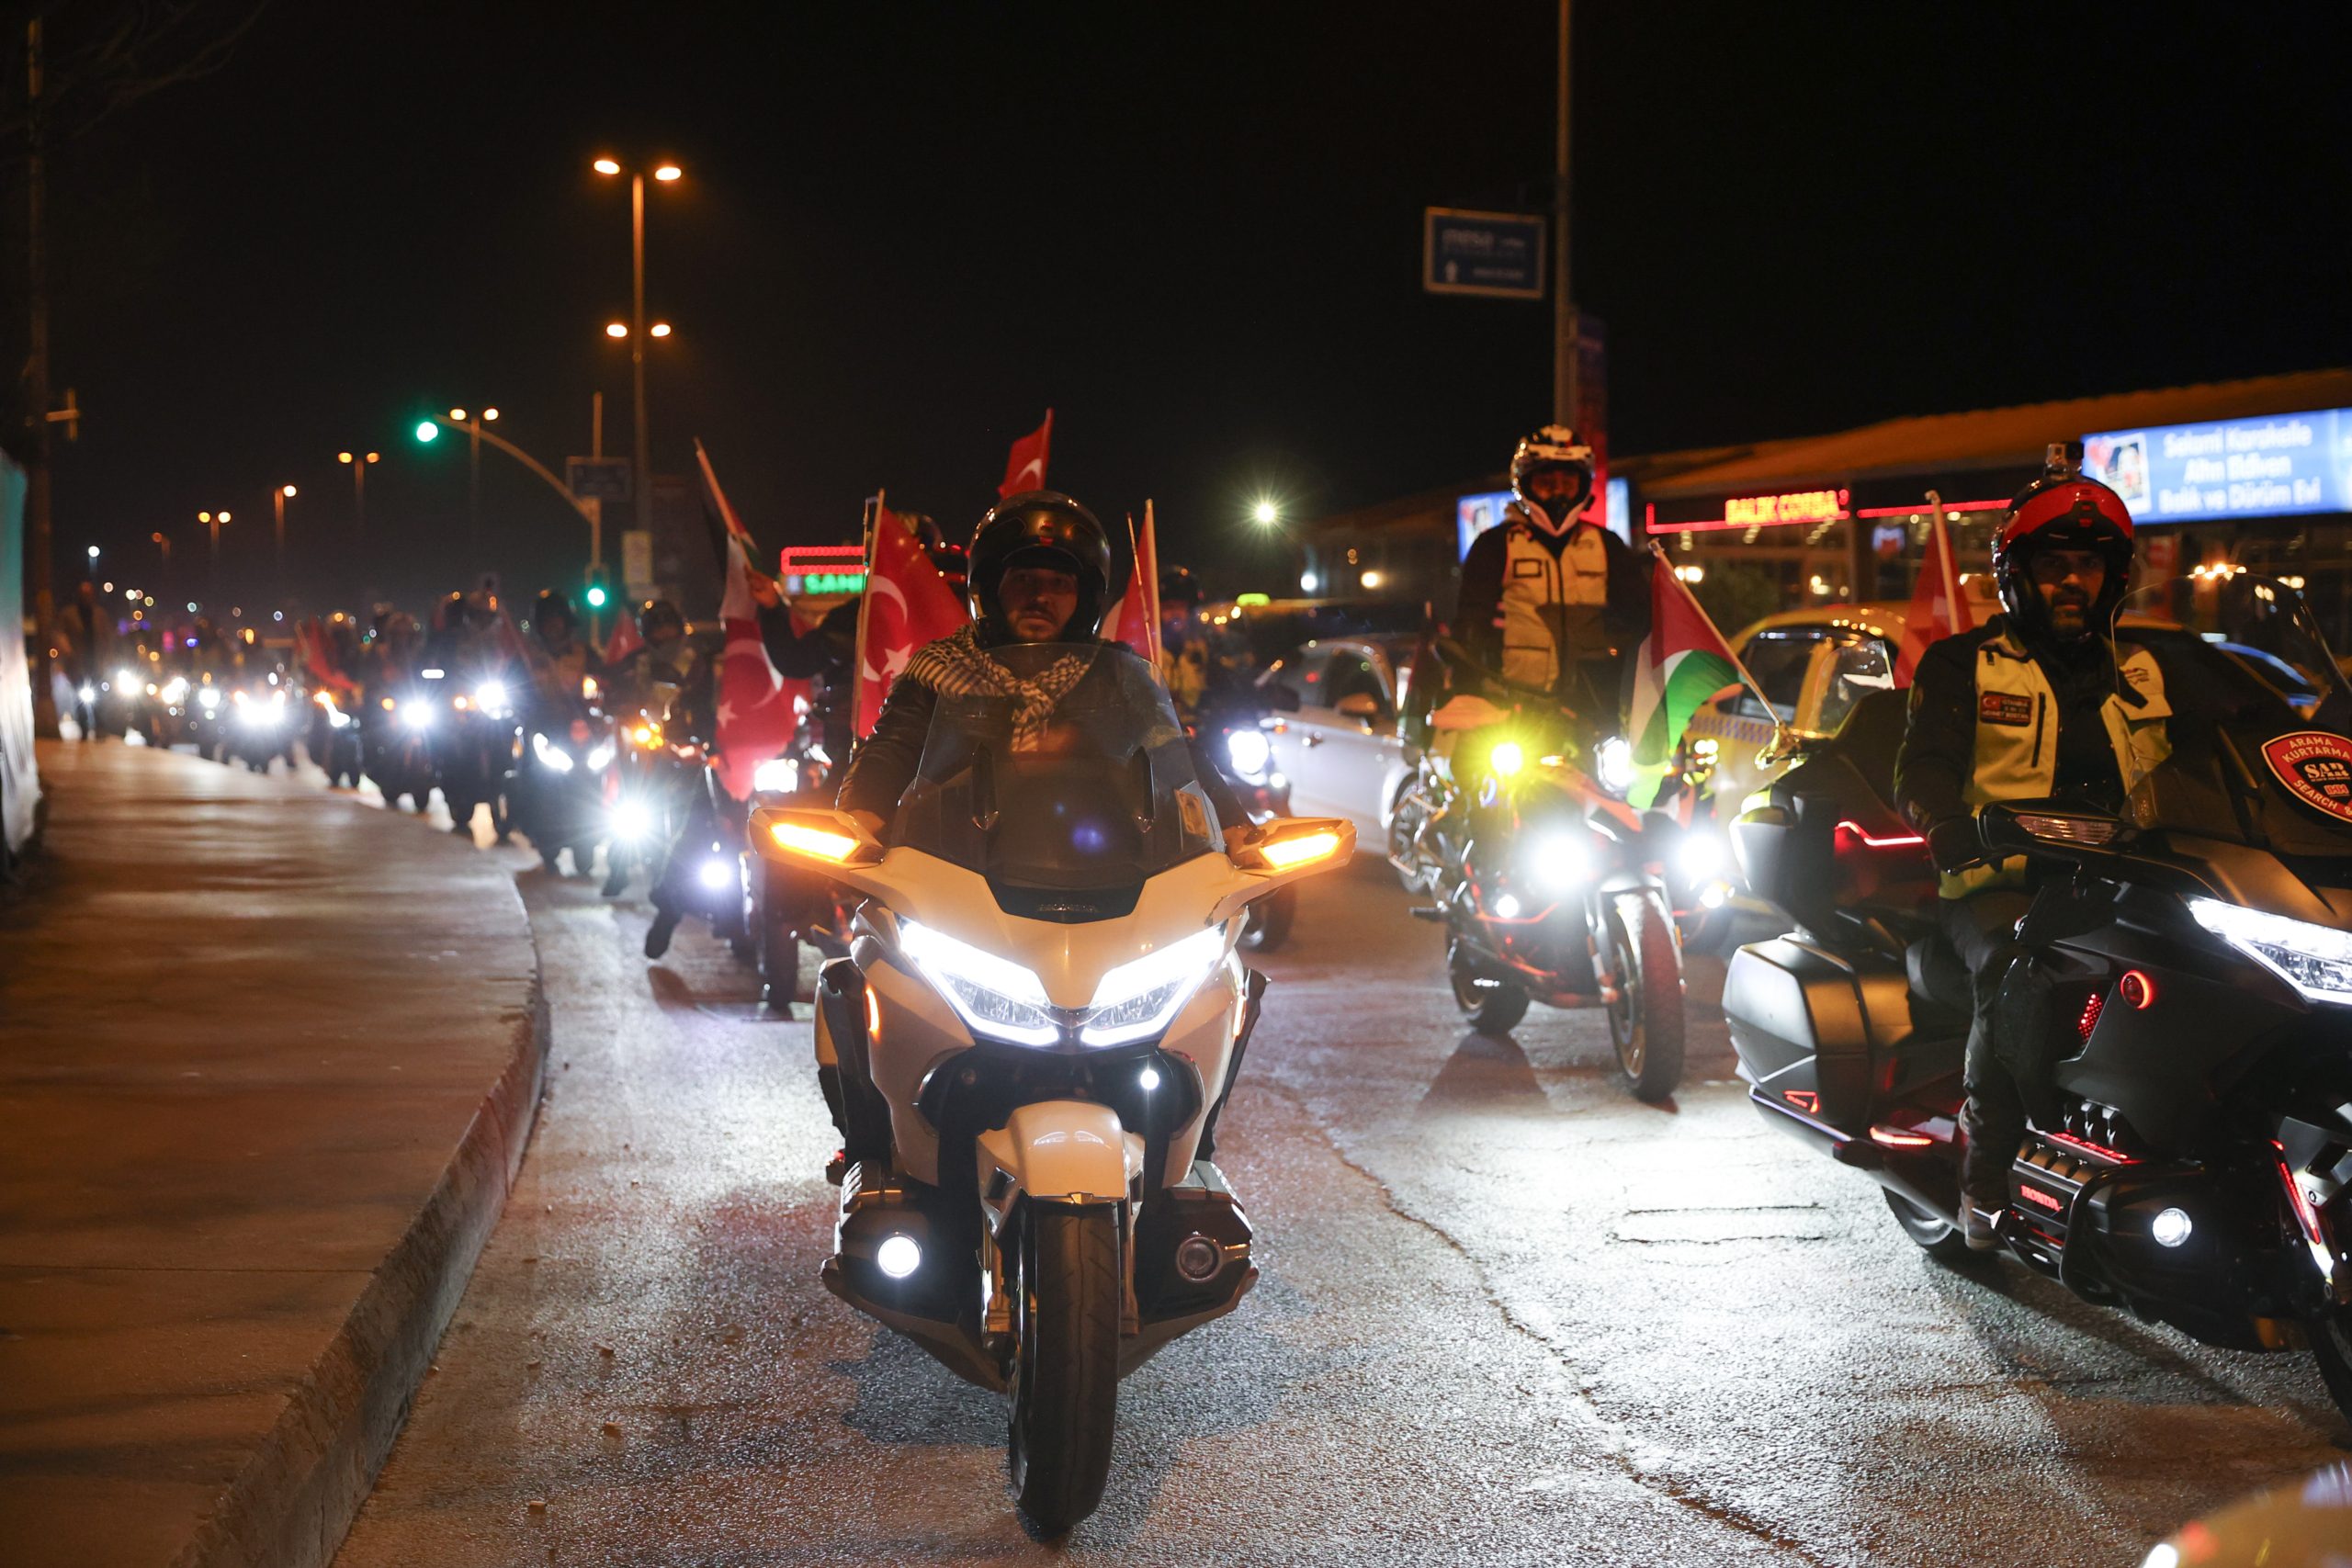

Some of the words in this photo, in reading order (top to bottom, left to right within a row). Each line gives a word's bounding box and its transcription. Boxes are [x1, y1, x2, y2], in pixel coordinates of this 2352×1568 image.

[2289, 737, 2333, 749] ARAMA
[2281, 747, 2350, 763] KURTARMA
[2303, 762, 2349, 779] SAR
[2293, 779, 2338, 810] SEARCH
[2020, 1184, 2060, 1213] HONDA
